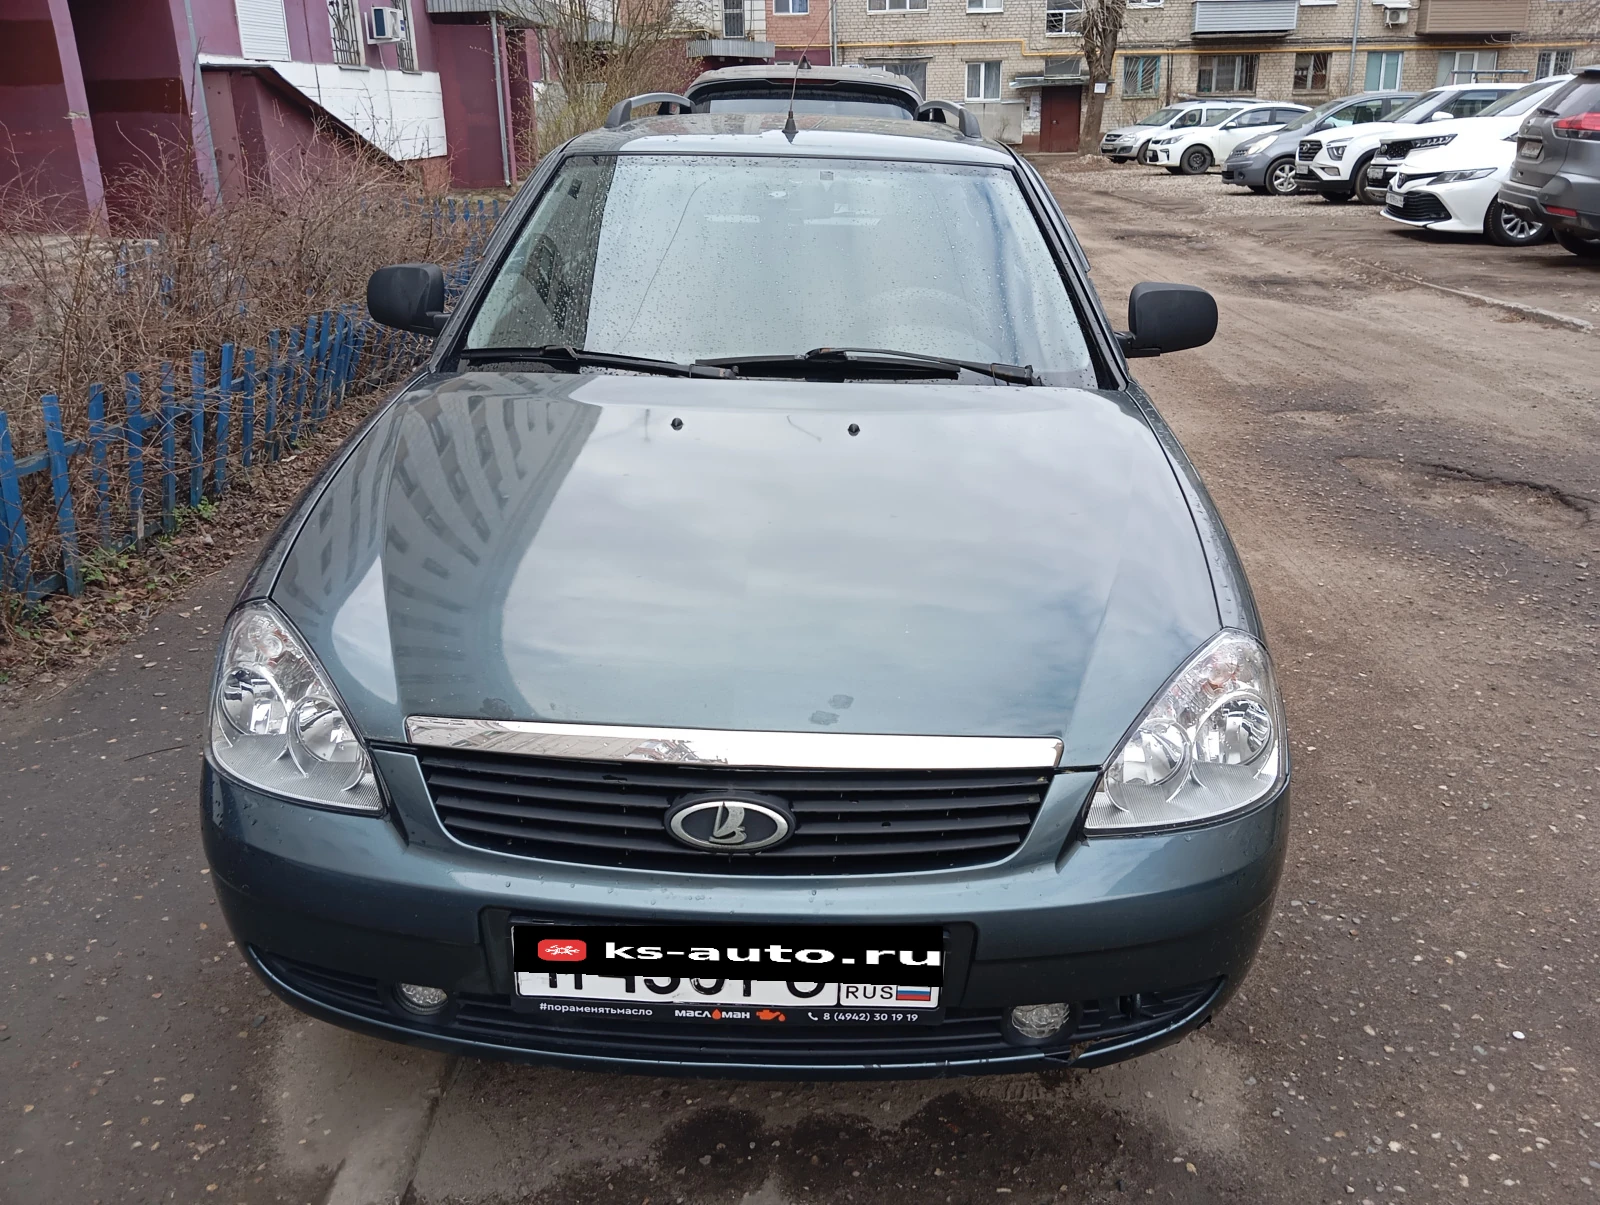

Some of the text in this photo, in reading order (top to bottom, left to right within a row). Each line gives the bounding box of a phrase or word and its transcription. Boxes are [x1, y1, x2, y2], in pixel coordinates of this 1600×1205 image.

[845, 985, 894, 1000] RUS
[539, 1002, 653, 1017] #пораменятьмасло
[823, 1012, 919, 1022] 8 (4942) 30 19 19
